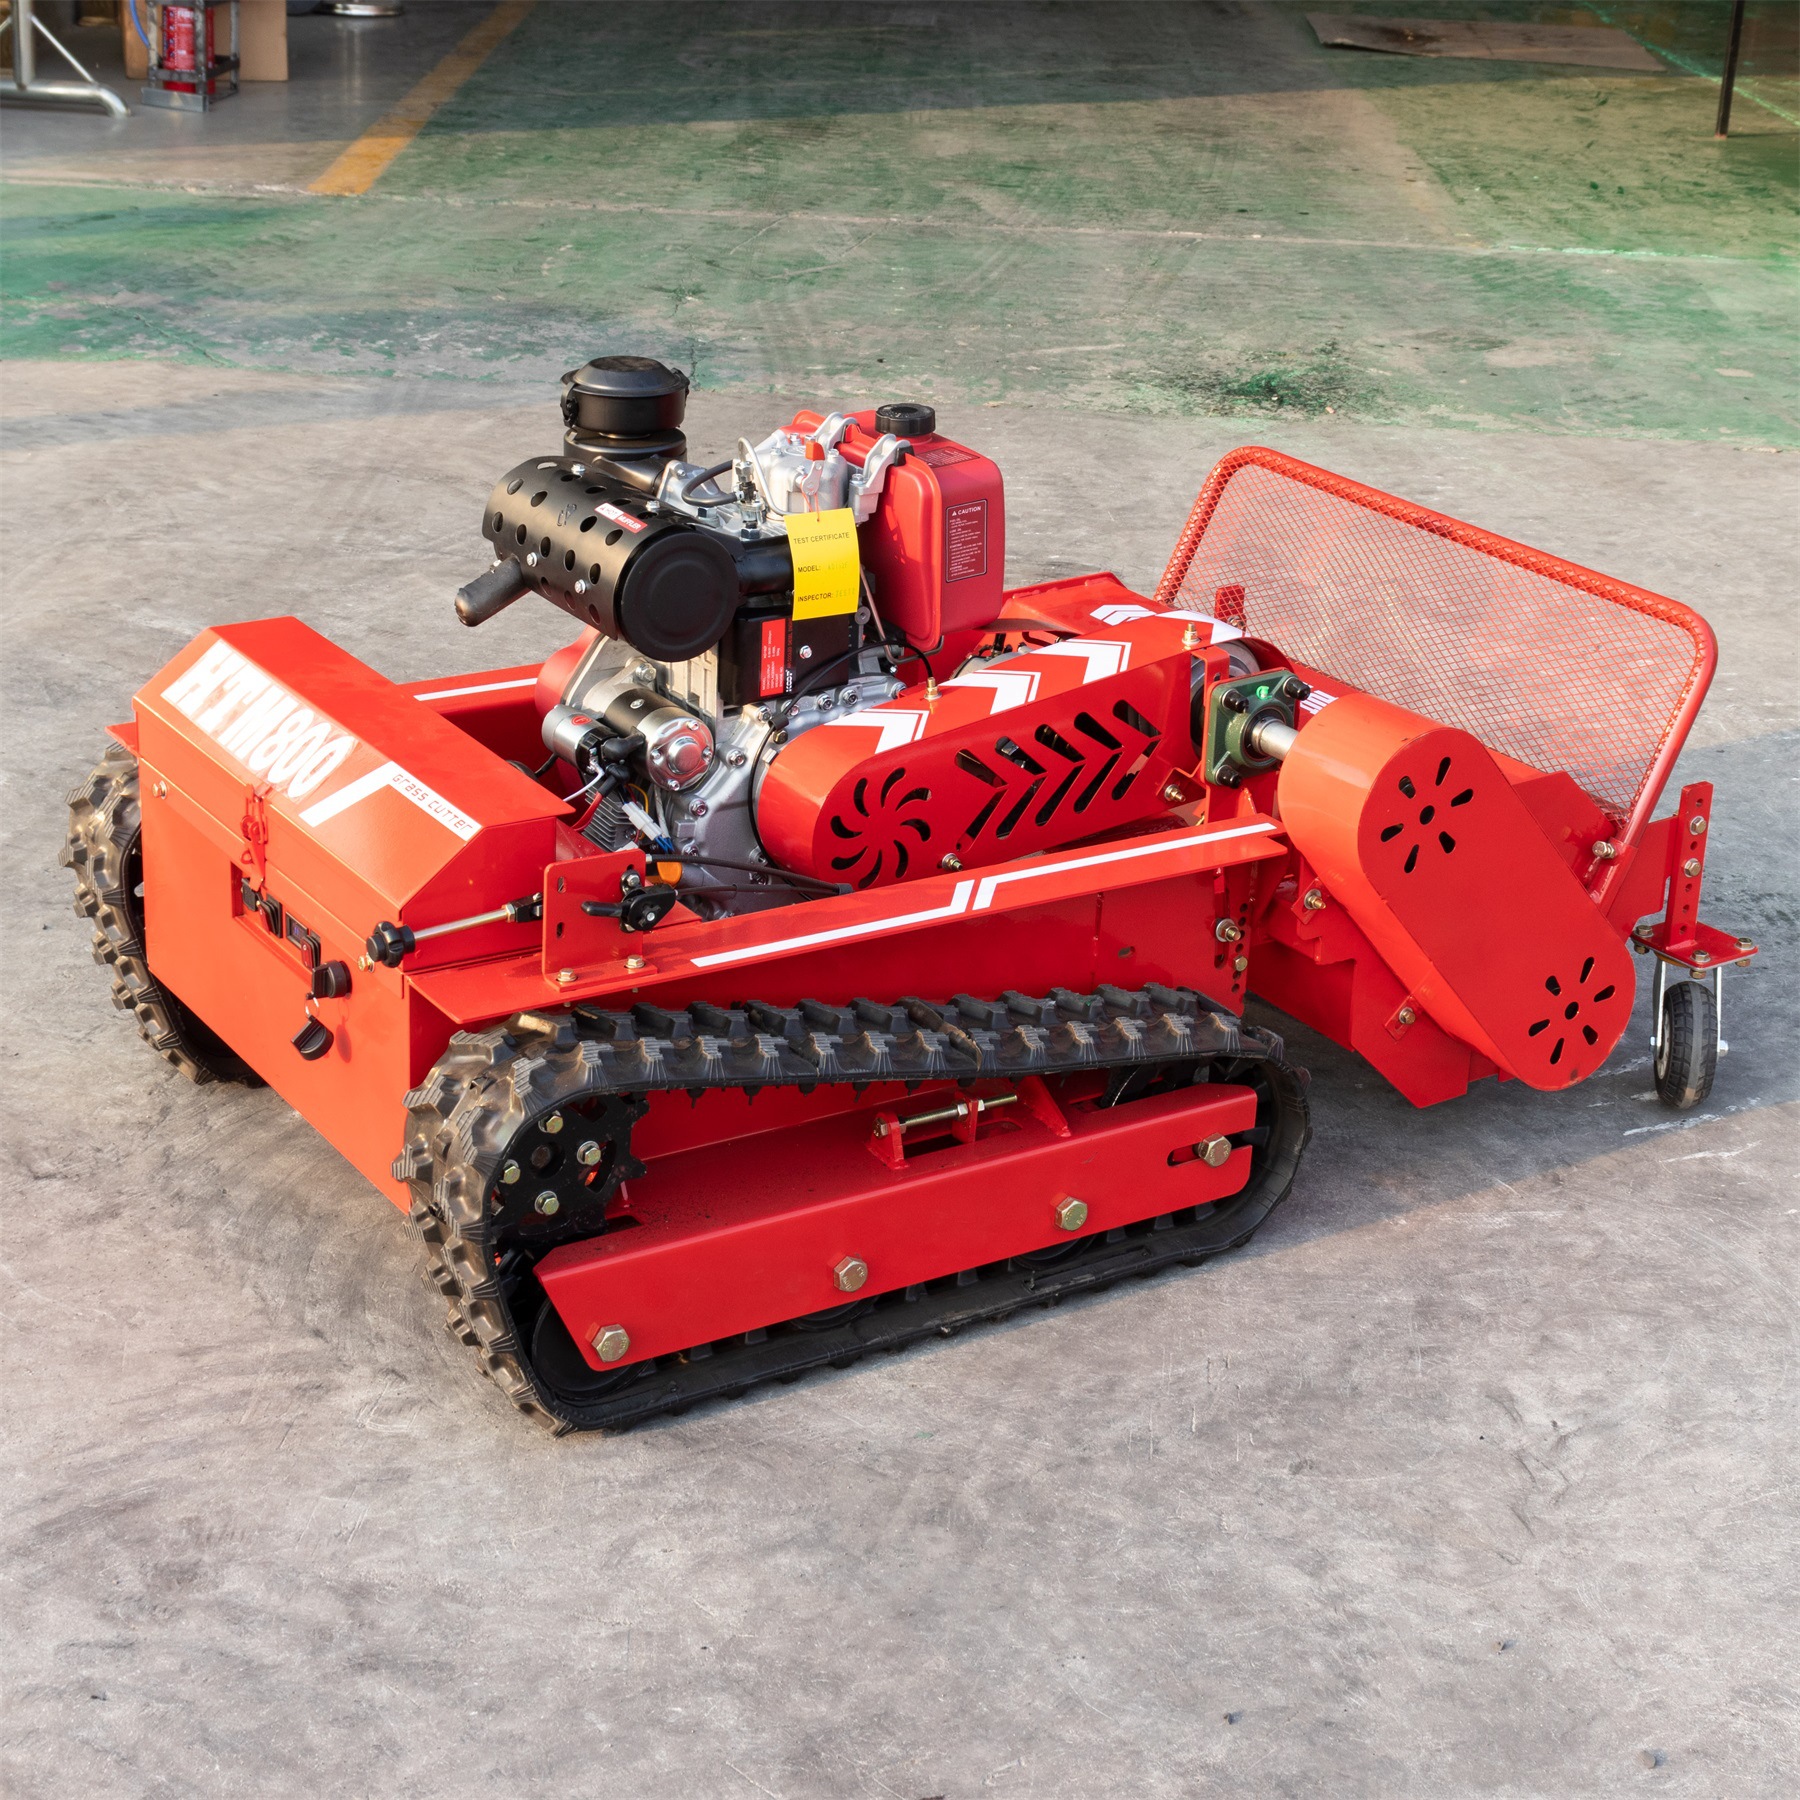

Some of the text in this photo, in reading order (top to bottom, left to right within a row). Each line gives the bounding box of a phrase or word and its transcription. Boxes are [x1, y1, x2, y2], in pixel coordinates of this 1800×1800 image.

[958, 506, 981, 515] CAUTION
[617, 515, 642, 530] MUFFLER
[793, 531, 850, 544] TEST CERTIFICATE
[797, 564, 821, 573] MODEL:
[797, 591, 833, 602] INSPECTOR:
[160, 638, 356, 798] HTM800
